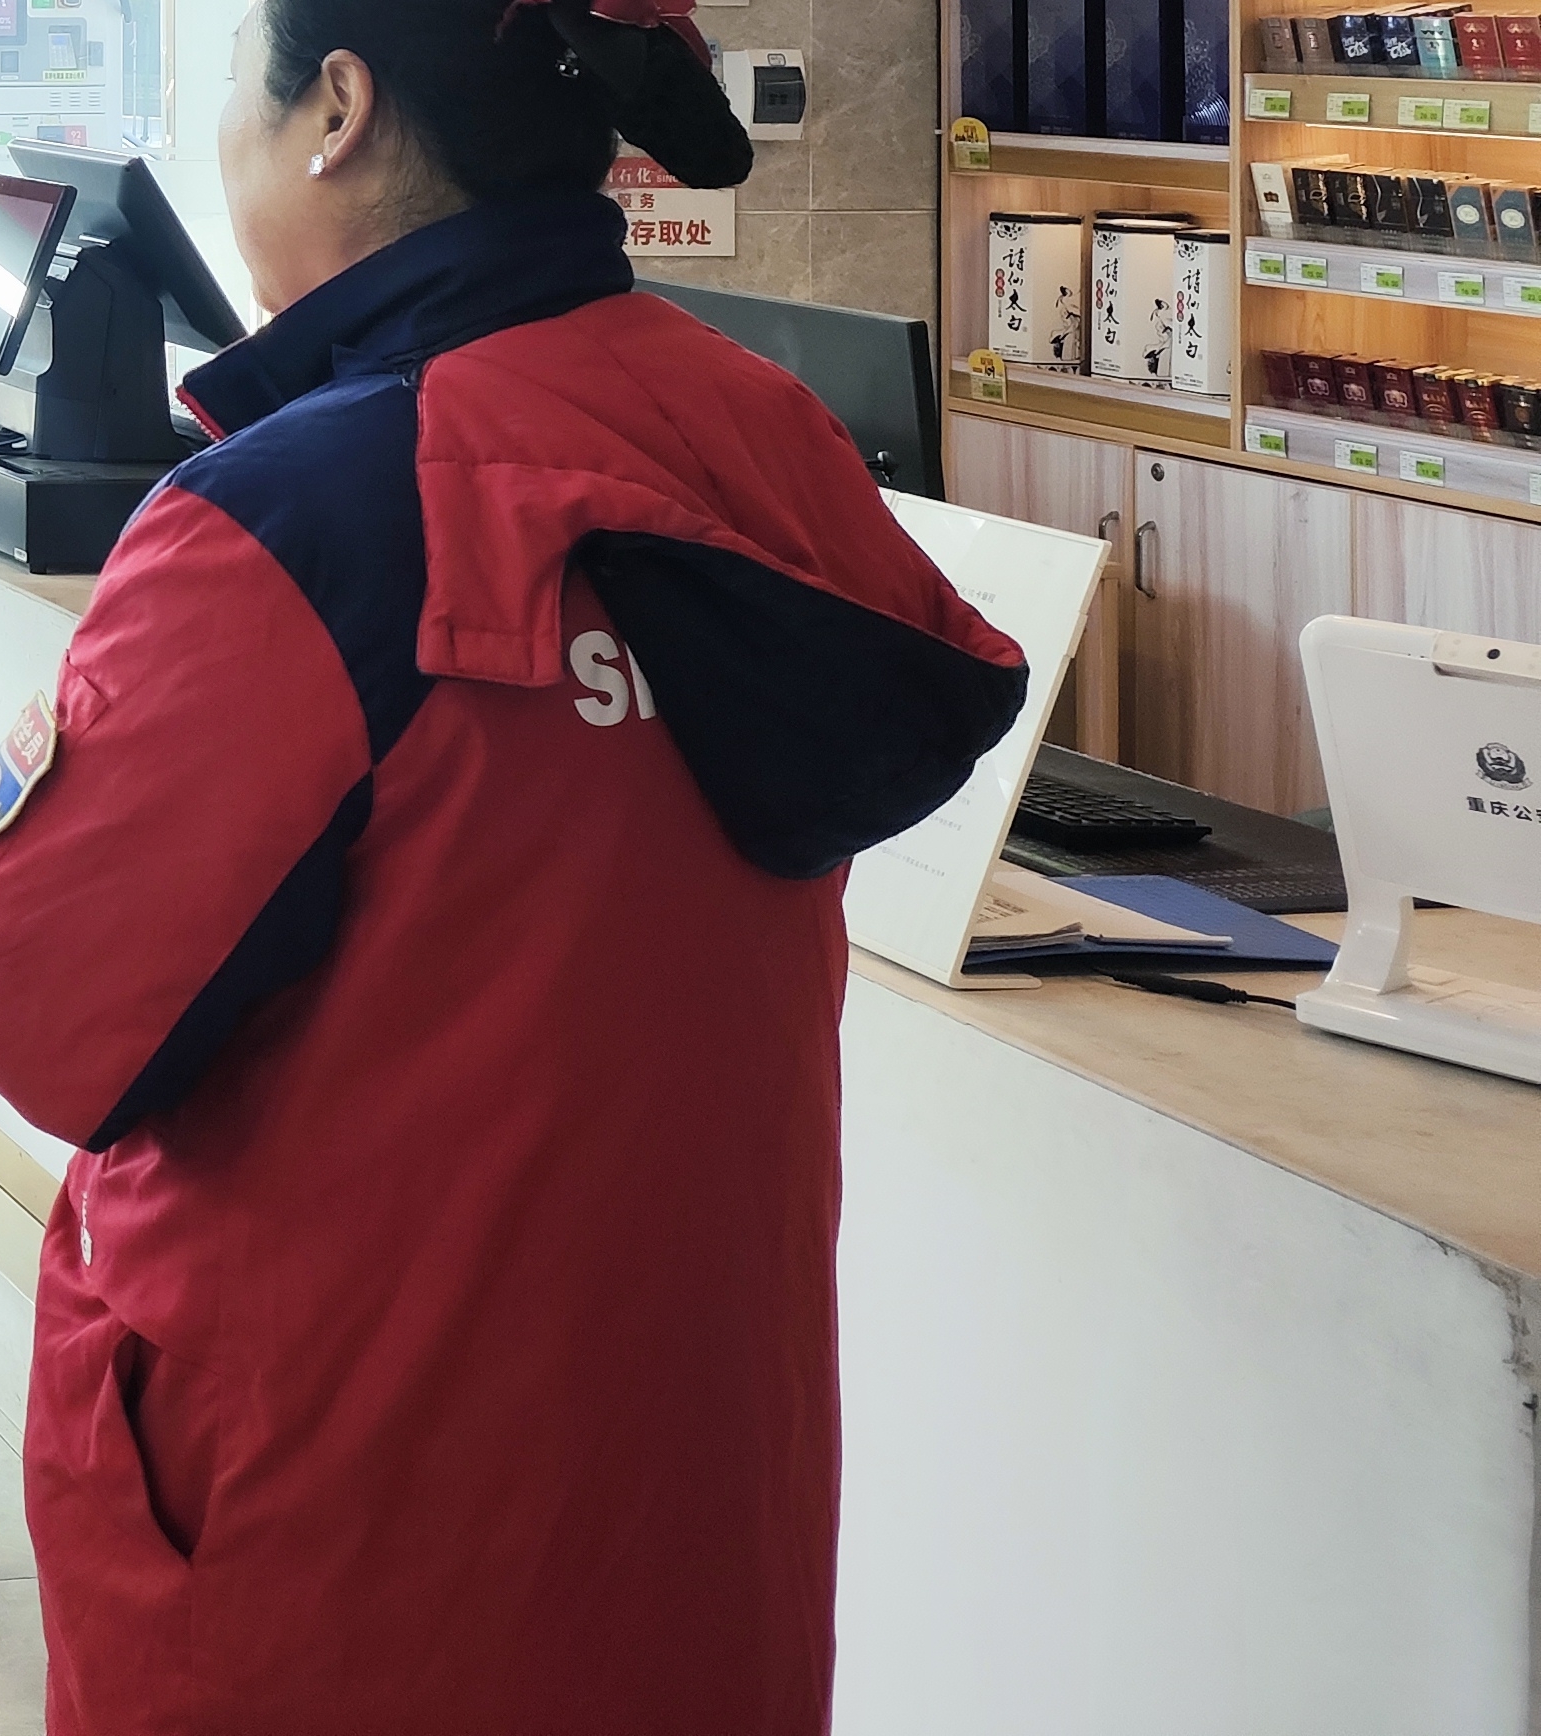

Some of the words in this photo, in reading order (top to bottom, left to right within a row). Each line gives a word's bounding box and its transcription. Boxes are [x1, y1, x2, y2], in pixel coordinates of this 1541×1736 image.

[609, 167, 652, 183] 石化
[618, 193, 655, 208] 服务
[624, 220, 712, 246] 存取处
